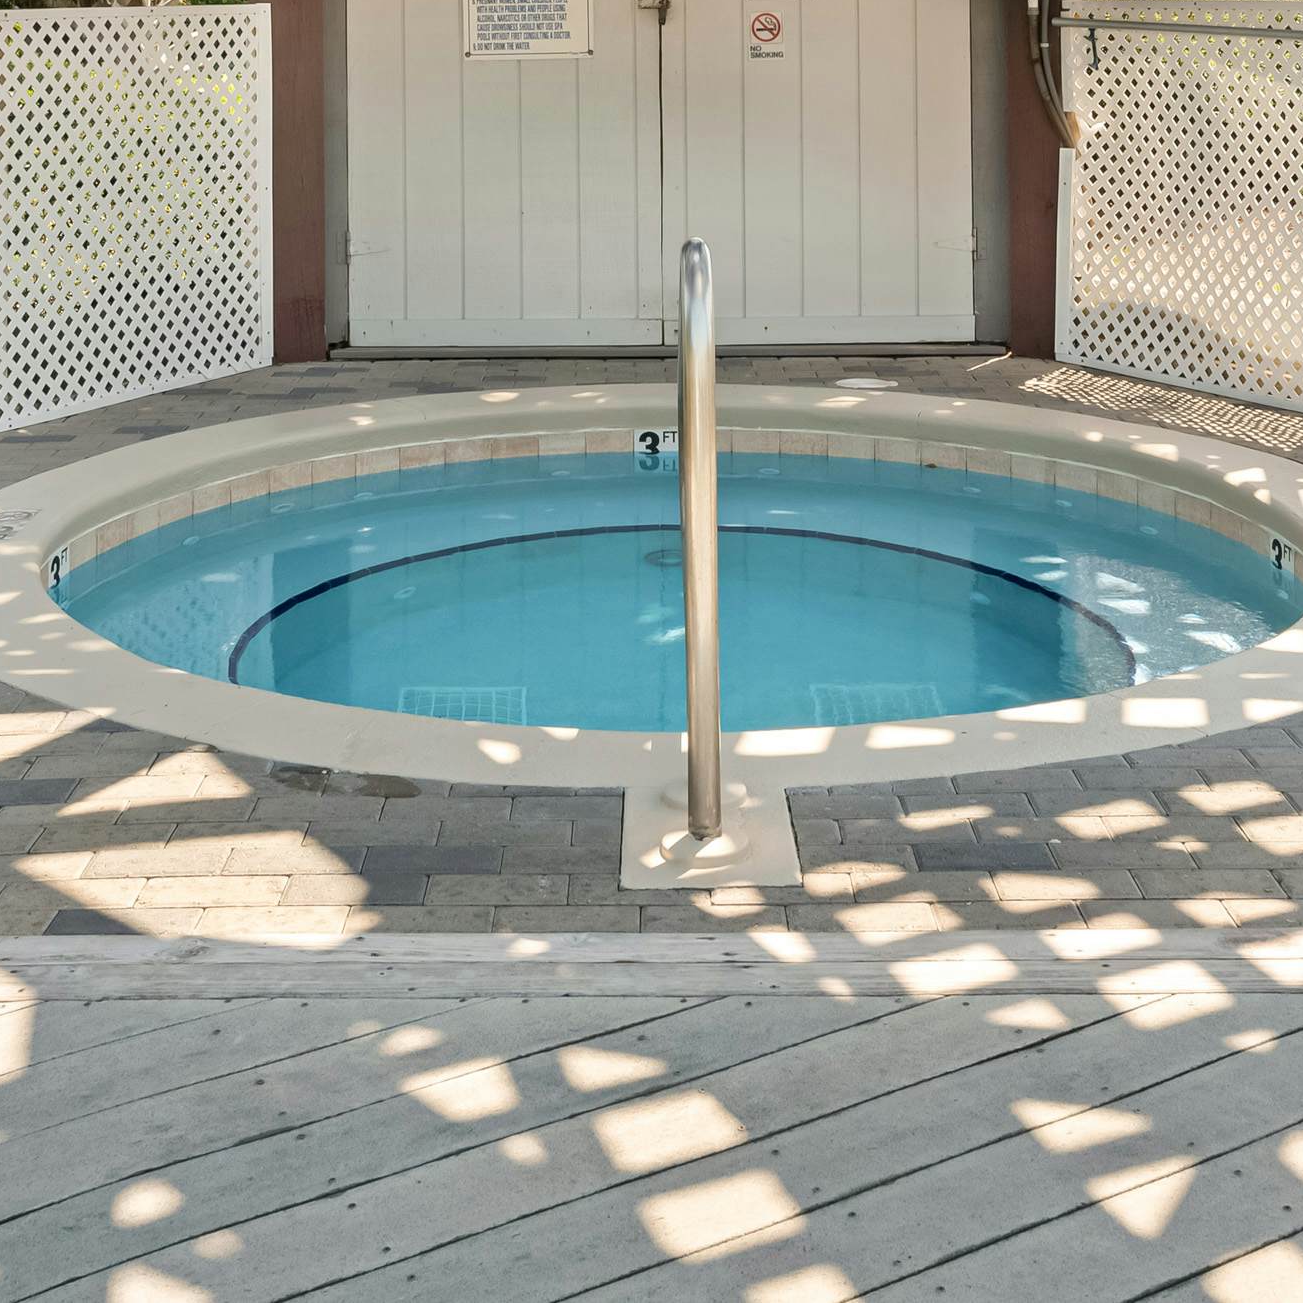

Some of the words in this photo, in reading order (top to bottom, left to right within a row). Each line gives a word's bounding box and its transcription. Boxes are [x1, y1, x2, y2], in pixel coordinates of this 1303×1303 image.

[489, 5, 504, 13] HEALTH
[557, 13, 567, 21] THAT
[519, 23, 535, 31] SHOULD
[492, 32, 509, 40] WITHOUT
[494, 42, 505, 50] DRINK
[639, 432, 660, 455] 3
[663, 431, 677, 442] FT
[1272, 538, 1282, 570] 3
[1284, 544, 1291, 562] FT
[50, 556, 60, 589] 3
[61, 547, 68, 565] FT
